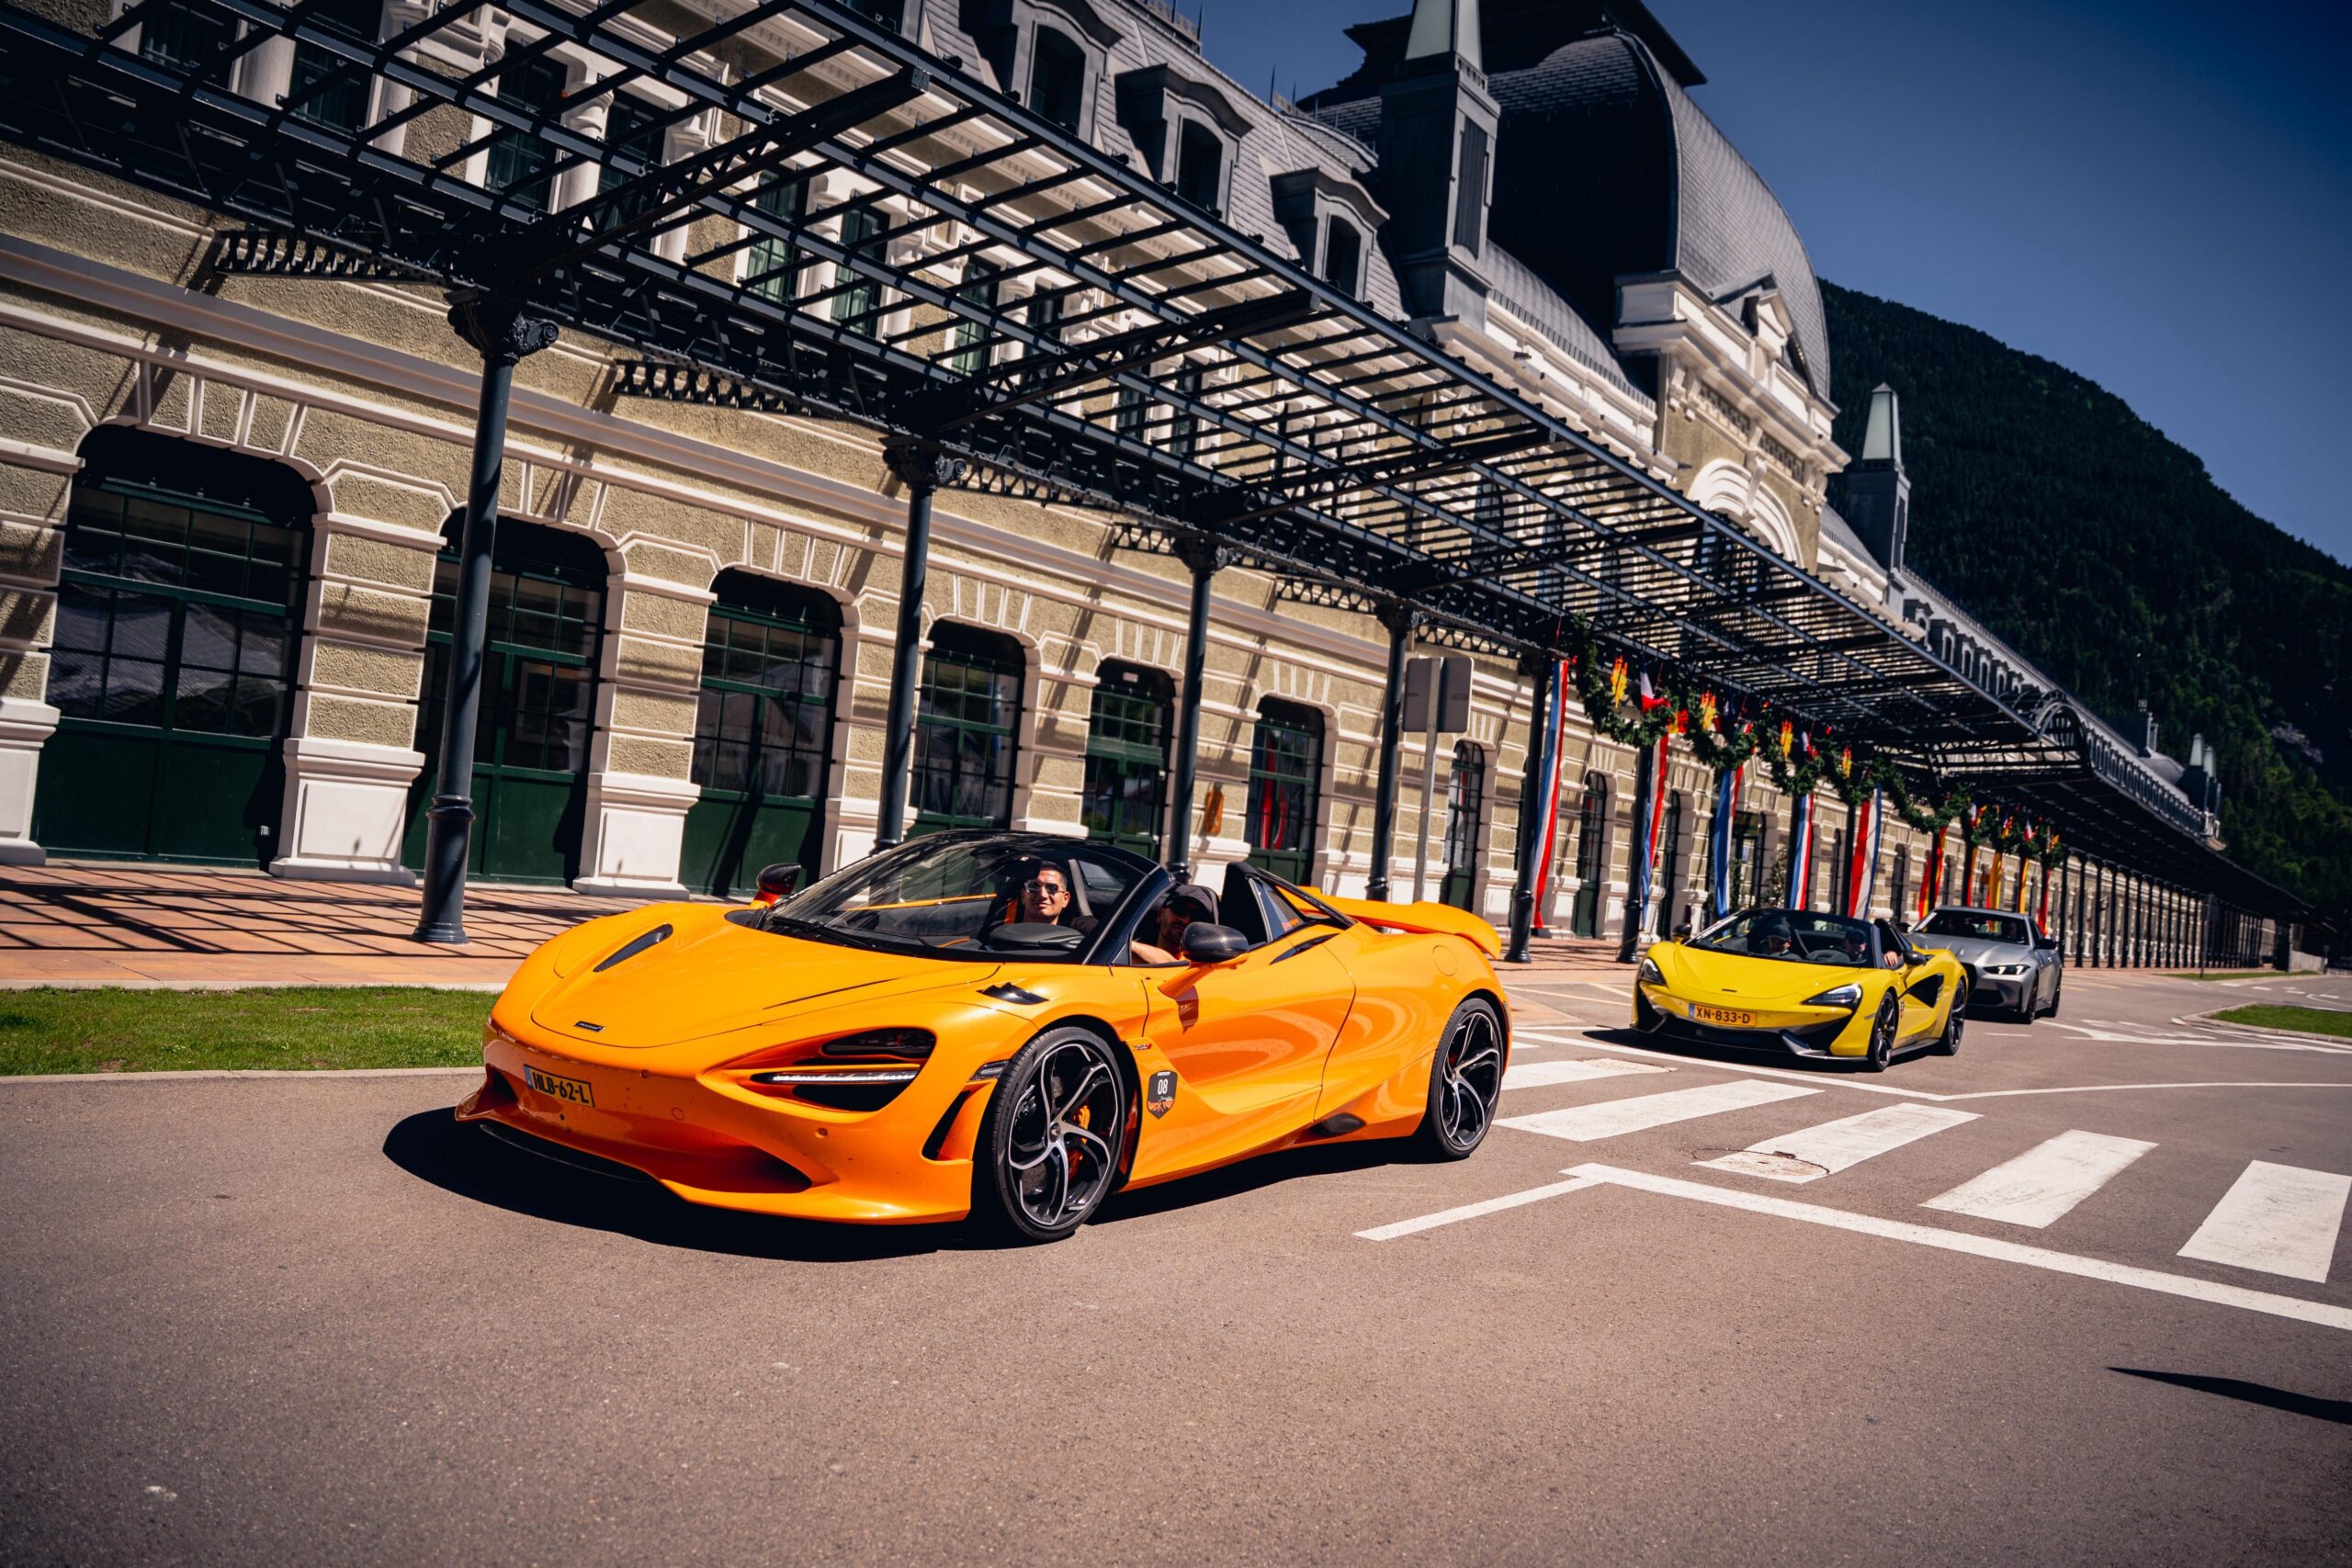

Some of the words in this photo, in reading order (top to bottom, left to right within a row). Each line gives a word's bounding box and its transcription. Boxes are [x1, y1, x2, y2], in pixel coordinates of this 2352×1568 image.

[1696, 1007, 1750, 1024] XN-833-D
[532, 1071, 589, 1104] HLB-62-L
[1158, 1078, 1169, 1095] 08
